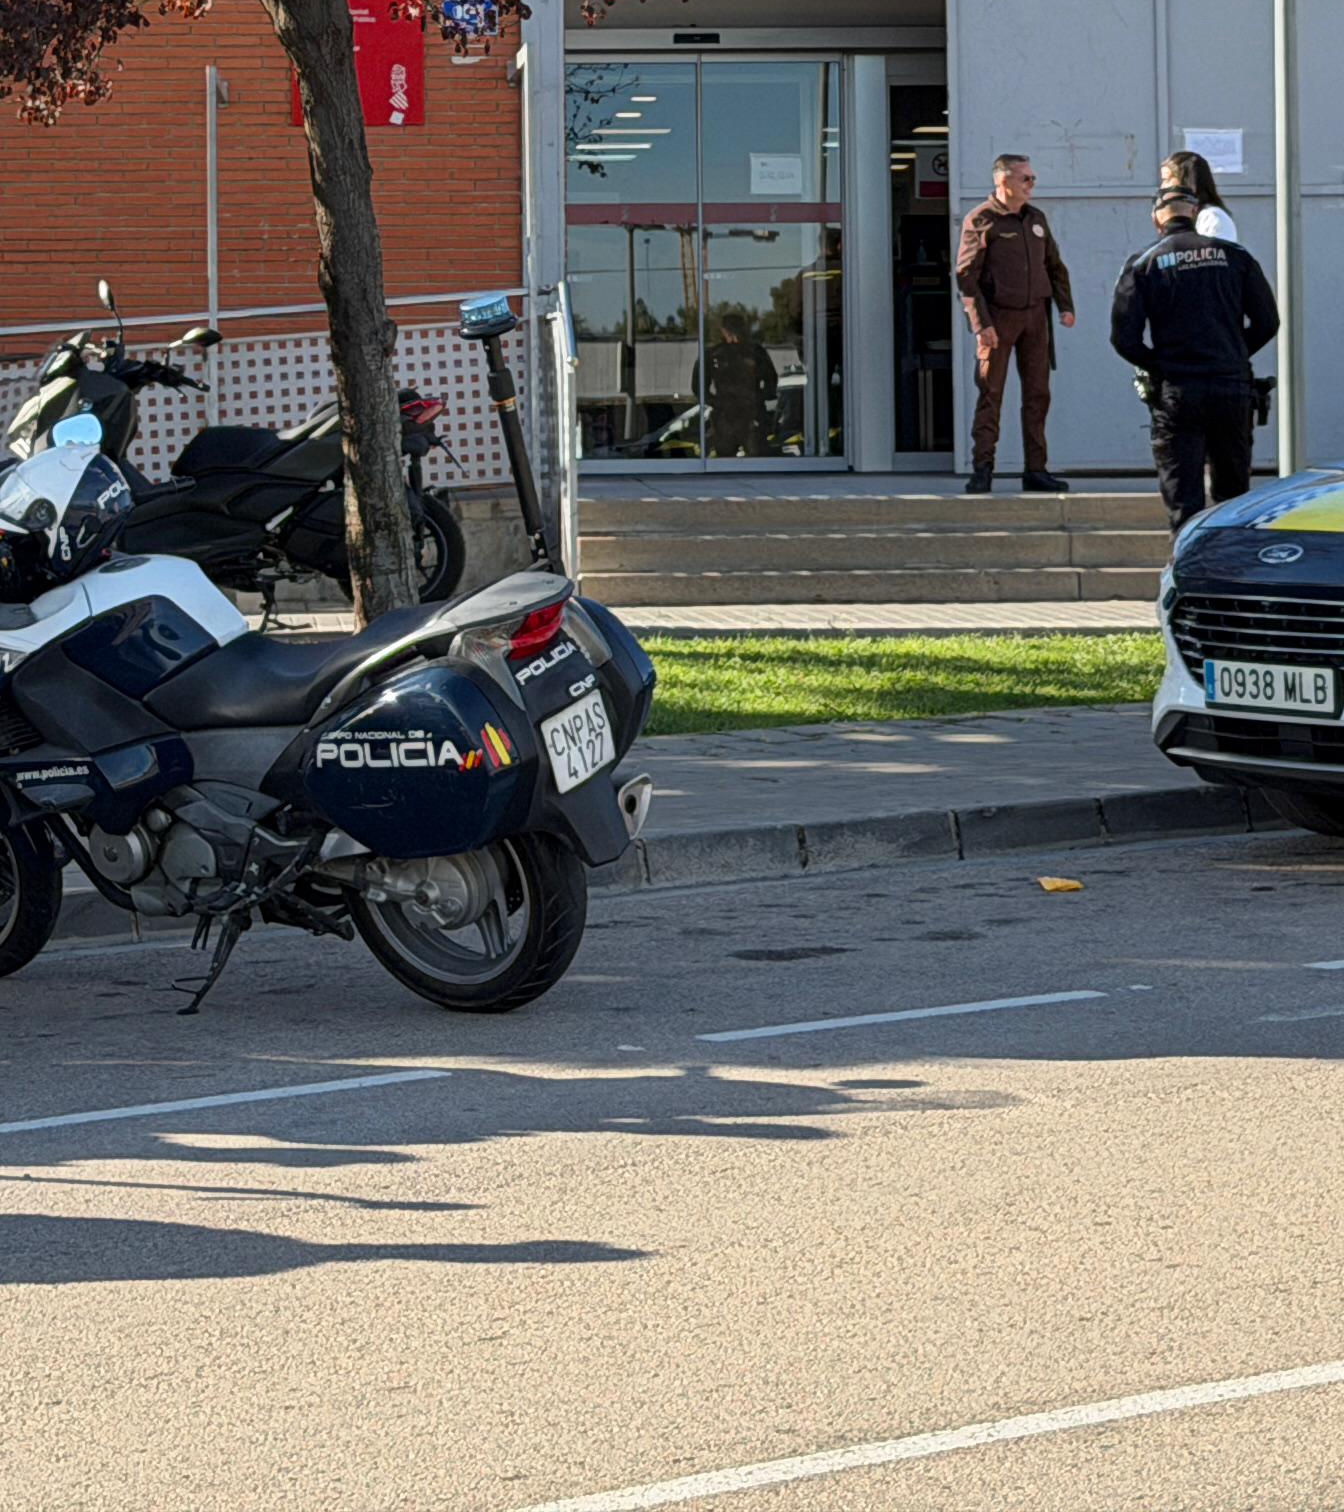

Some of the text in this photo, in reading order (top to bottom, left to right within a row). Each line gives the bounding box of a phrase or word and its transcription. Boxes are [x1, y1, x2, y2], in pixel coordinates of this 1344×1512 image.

[569, 674, 596, 698] CNP
[1220, 666, 1328, 705] 0938 MLB
[316, 732, 464, 769] POLICÍA
[566, 731, 605, 779] 4127
